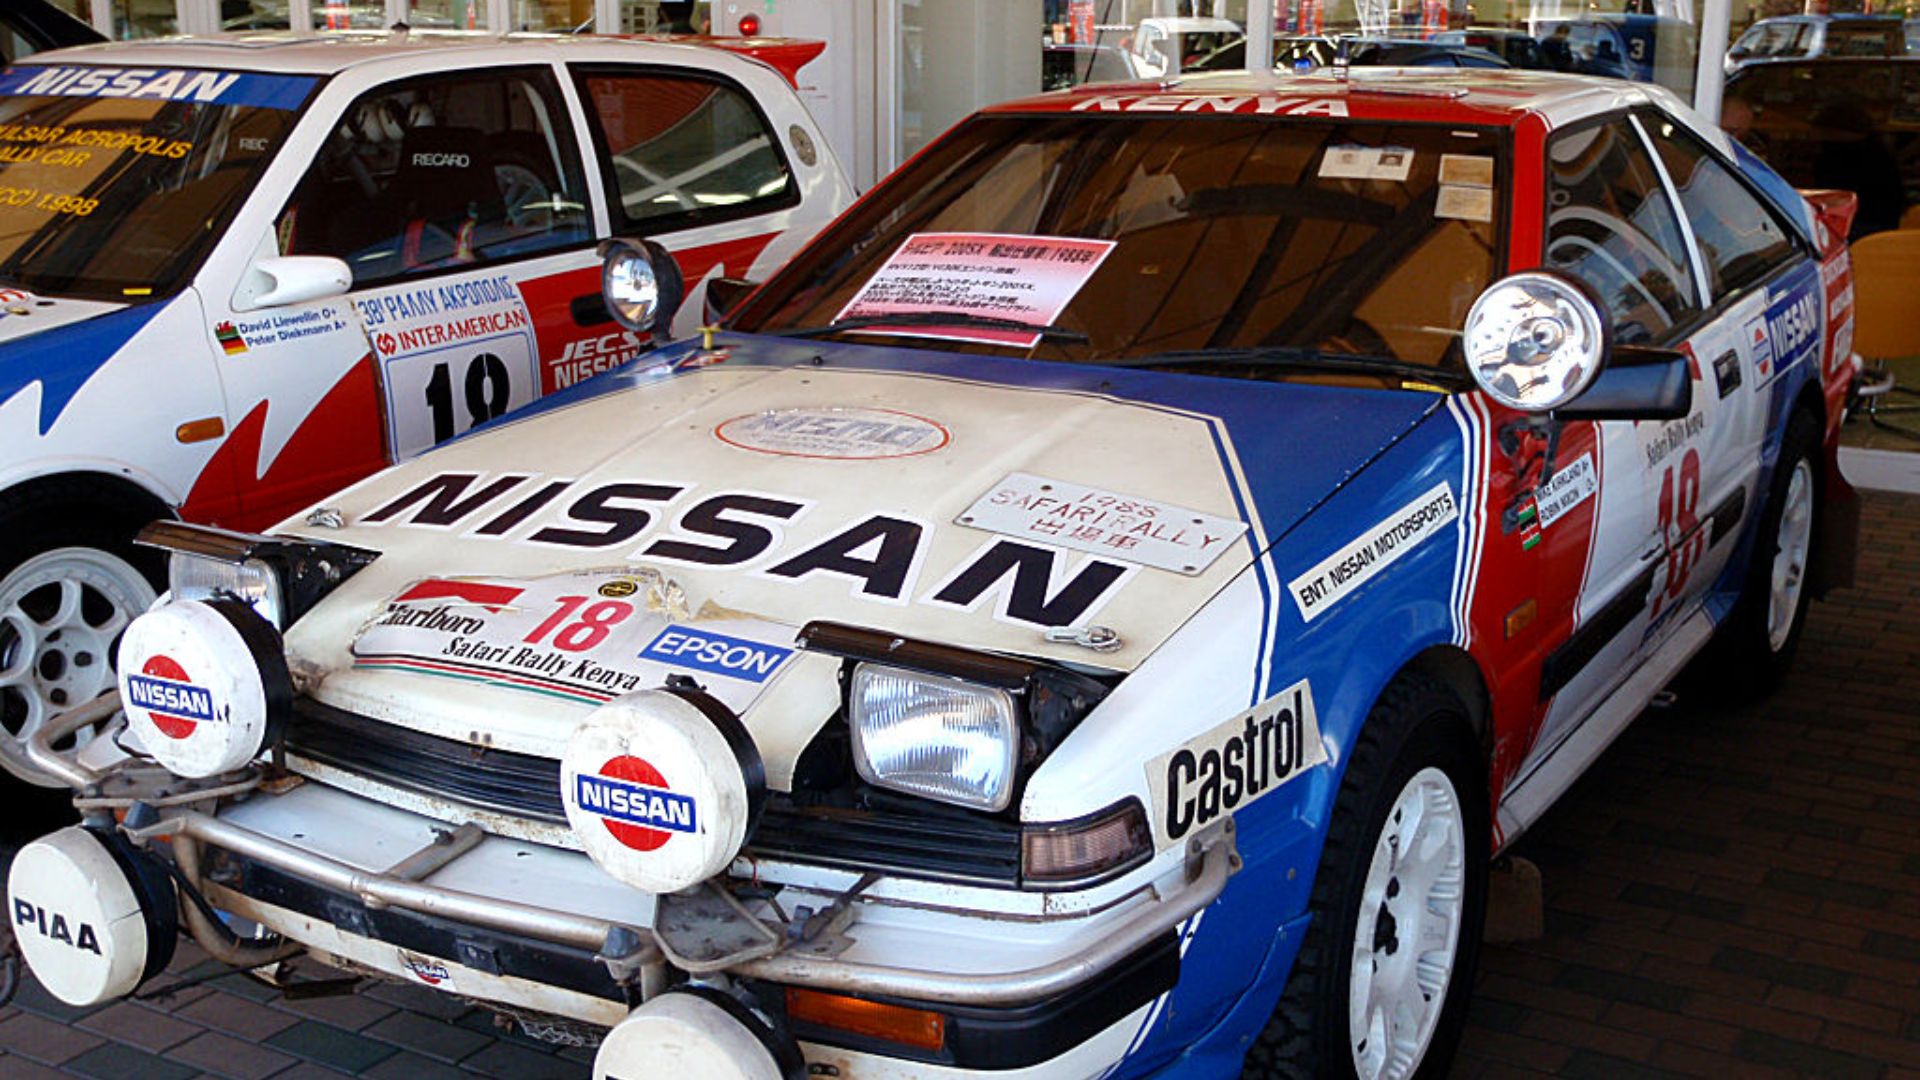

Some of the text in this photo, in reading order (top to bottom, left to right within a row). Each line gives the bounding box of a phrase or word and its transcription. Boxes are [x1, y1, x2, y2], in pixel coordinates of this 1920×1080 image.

[1630, 38, 1645, 60] 3
[14, 68, 241, 102] NISSAN
[1071, 95, 1350, 117] KENYA
[41, 149, 91, 168] CAR
[65, 129, 193, 159] ACROPOLIS
[412, 153, 470, 168] RECARO
[238, 320, 271, 334] David
[246, 334, 276, 348] Peter
[398, 309, 527, 351] INTERAMERICAN
[1770, 292, 1817, 362] NISSAN
[548, 331, 640, 366] JECS
[989, 489, 1110, 525] SAFARI
[362, 474, 1128, 629] NISSAN
[1328, 543, 1376, 588] NISSAN
[1373, 492, 1453, 558] MOTORSPORTS
[522, 595, 634, 653] 18
[442, 636, 641, 692] Safari Rally Kenya
[651, 632, 781, 675] EPSON
[131, 681, 210, 716] NISSAN
[1166, 689, 1304, 840] Castrol
[582, 780, 692, 827] NISSAN
[13, 897, 103, 956] PIAA
